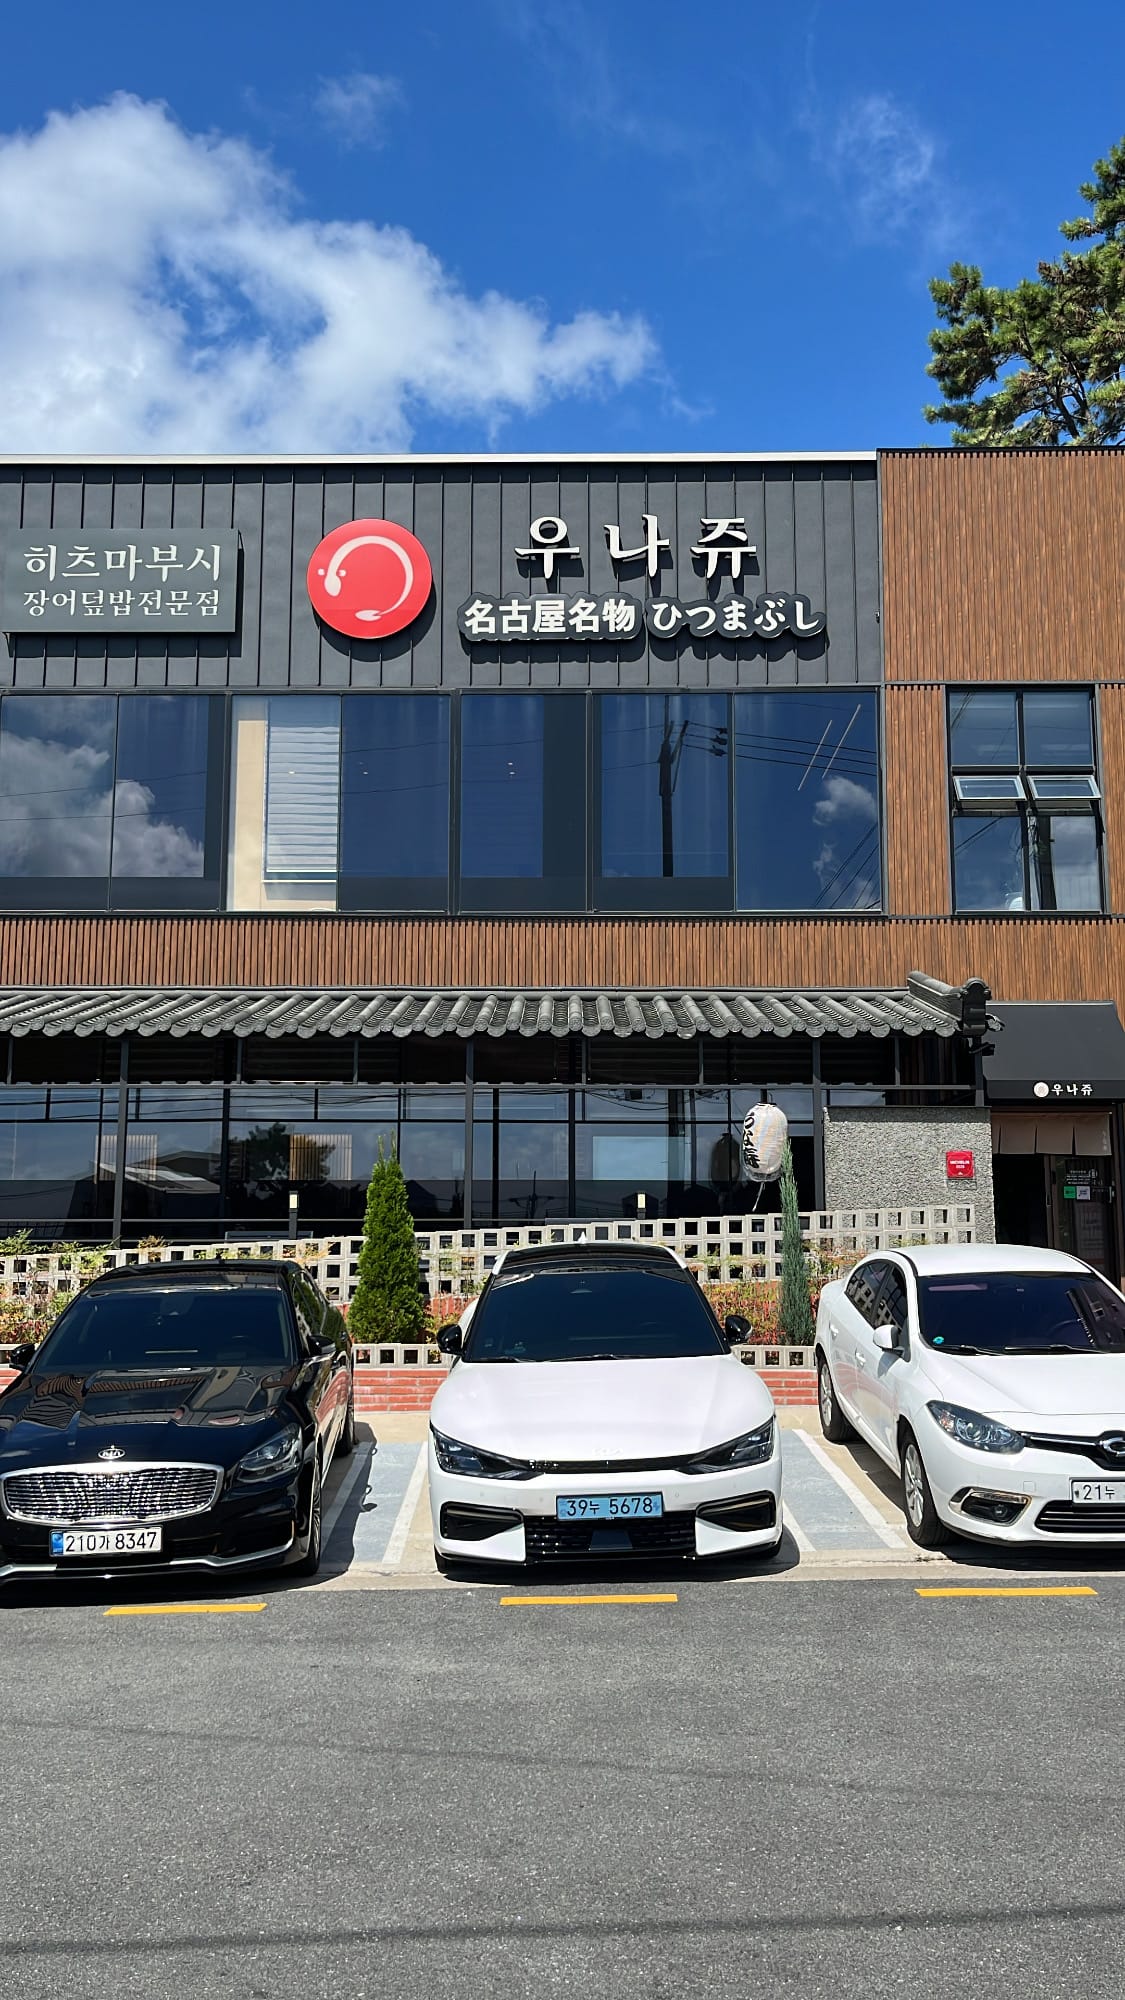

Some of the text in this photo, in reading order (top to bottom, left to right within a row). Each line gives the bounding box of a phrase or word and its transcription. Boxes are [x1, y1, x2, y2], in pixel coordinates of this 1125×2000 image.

[514, 513, 757, 579] 우나쥬
[23, 544, 222, 582] 히츠마부시
[23, 589, 220, 617] 장어덮밥전문점
[464, 598, 822, 634] 名古屋名物 ひつまぶし
[1051, 1083, 1093, 1096] 우나쥬
[1082, 1484, 1116, 1501] 21누
[566, 1497, 653, 1516] 39누 5678
[65, 1531, 157, 1553] 210가 8347
